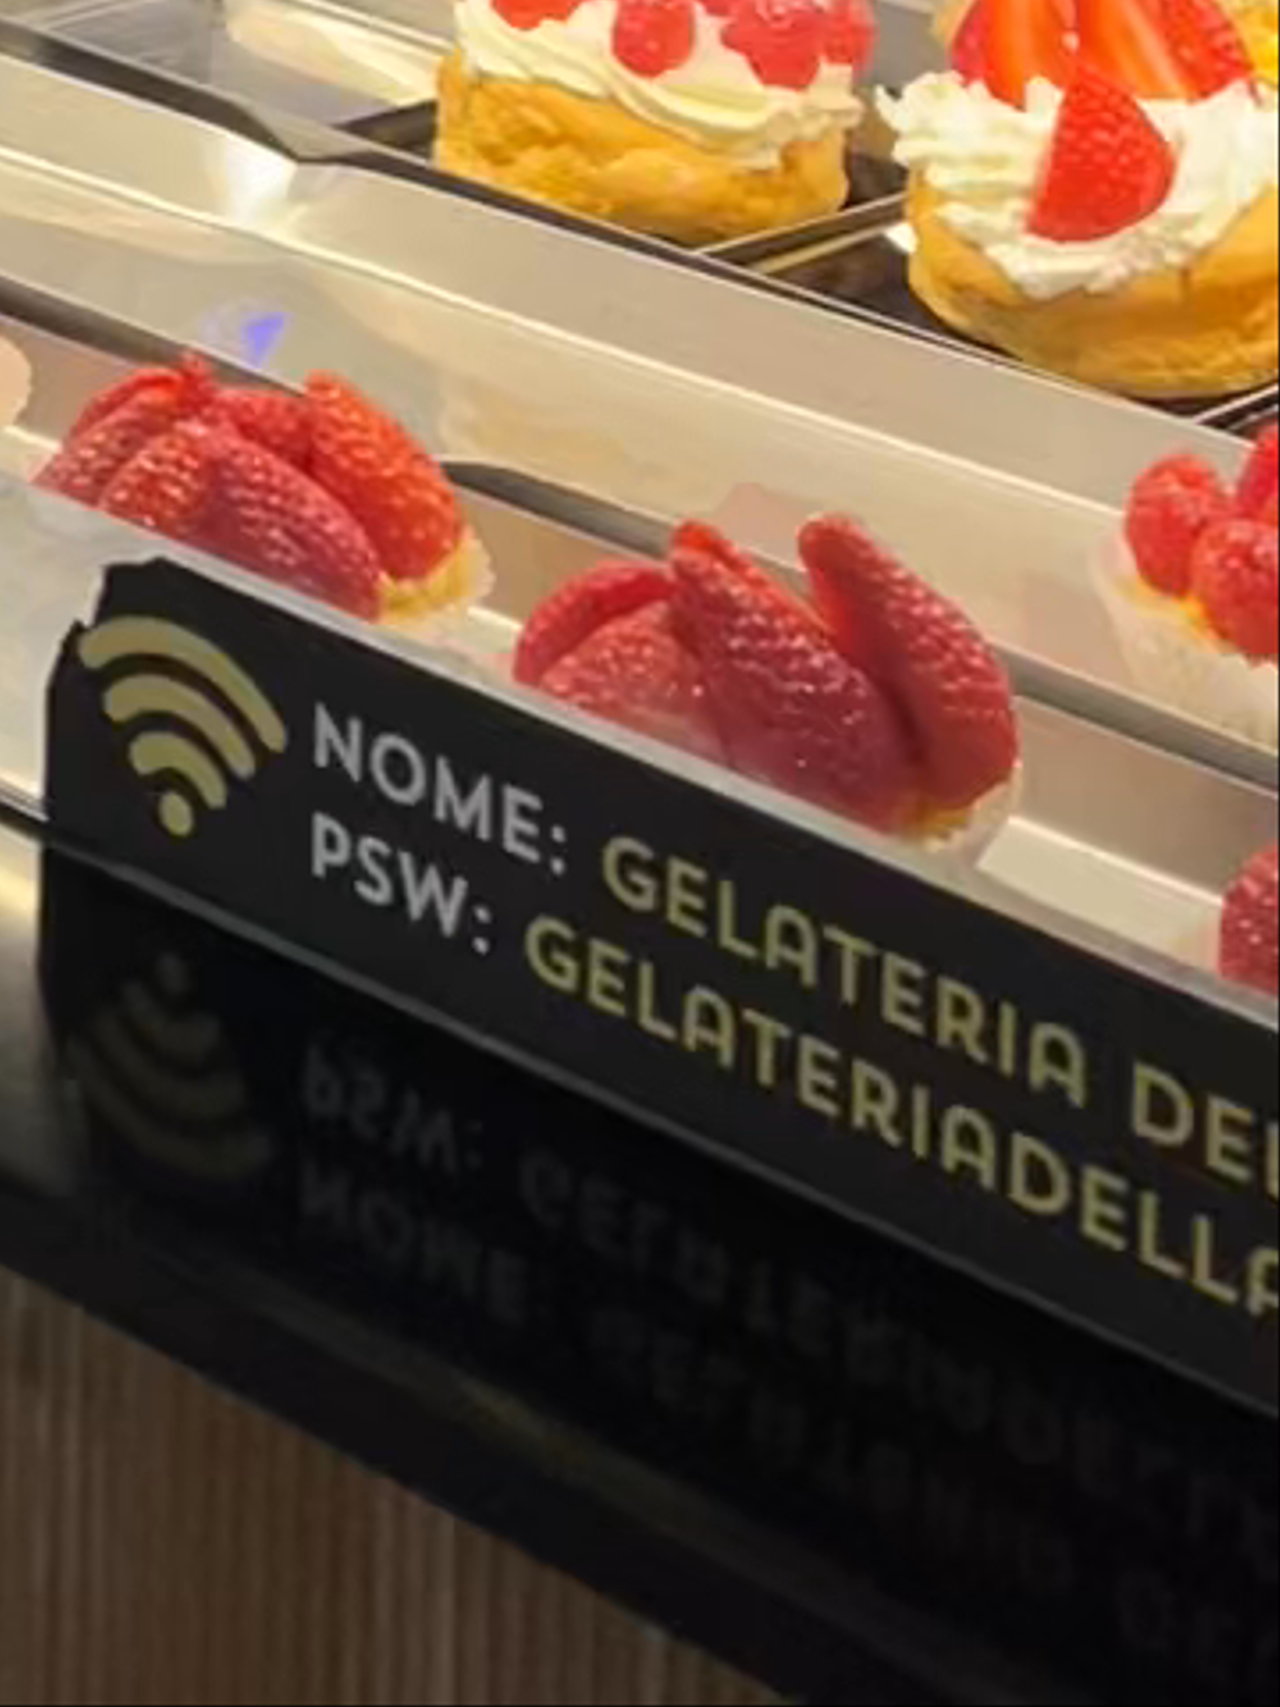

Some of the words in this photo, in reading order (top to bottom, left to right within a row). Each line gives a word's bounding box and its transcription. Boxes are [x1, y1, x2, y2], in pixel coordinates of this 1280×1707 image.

[311, 810, 492, 957] PSW:
[312, 699, 568, 877] NOME:
[601, 834, 1088, 1110] GELATERIA
